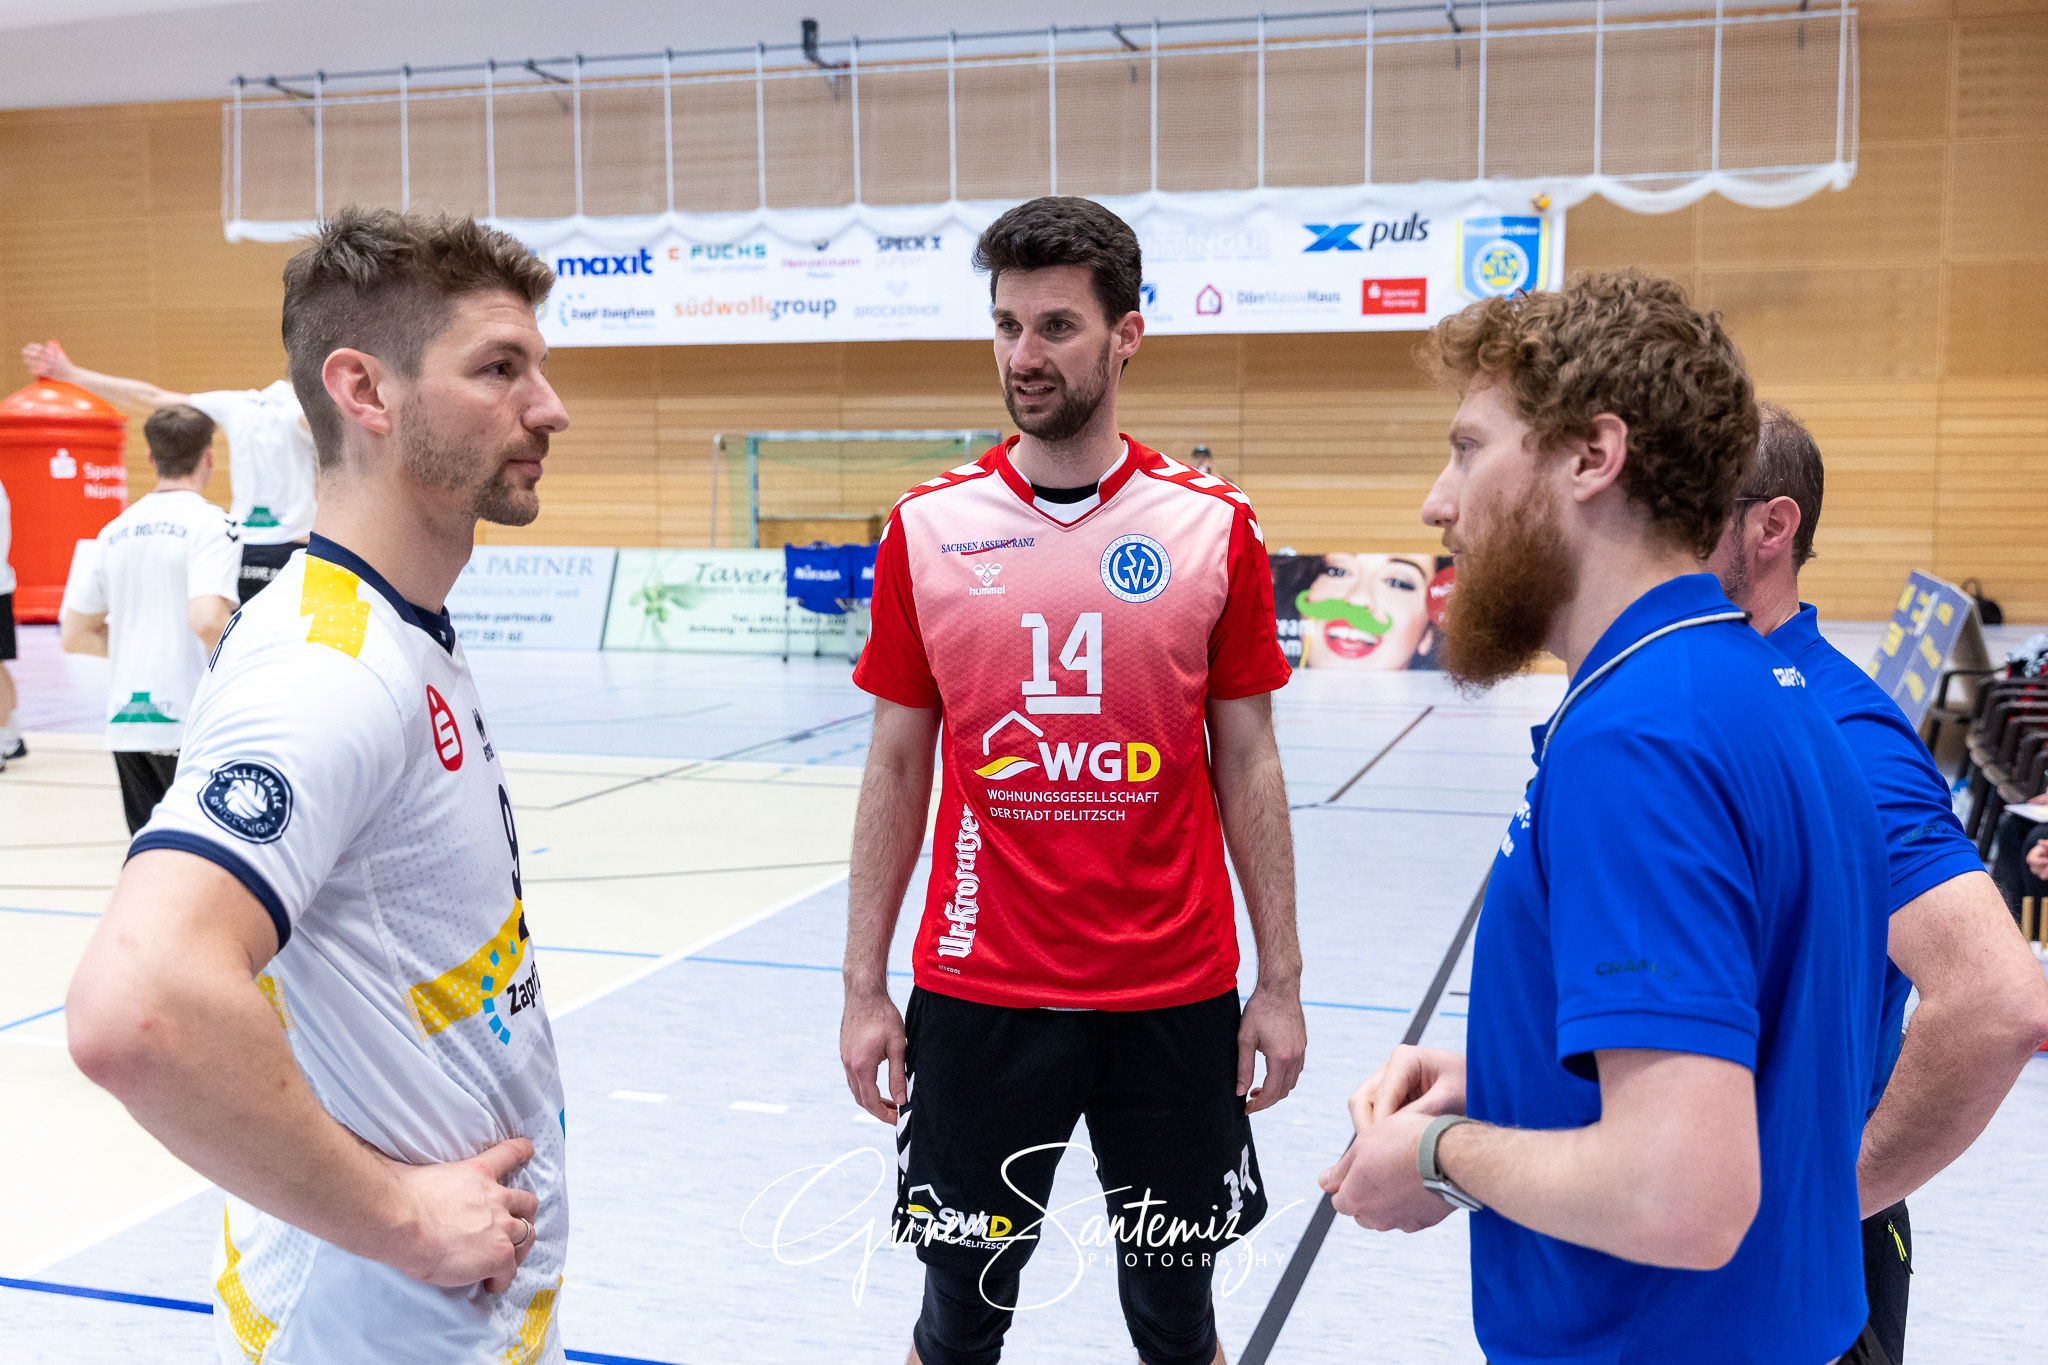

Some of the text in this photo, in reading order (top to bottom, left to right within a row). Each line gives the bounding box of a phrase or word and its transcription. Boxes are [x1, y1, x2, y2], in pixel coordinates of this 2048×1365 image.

[1370, 213, 1430, 250] puls
[558, 247, 653, 277] maxit
[691, 243, 768, 260] FUCHS
[941, 537, 1035, 553] SACHSEN ASSEKURANZ
[485, 556, 594, 577] PARTNER
[1102, 536, 1131, 581] GYMNASIALER
[1147, 540, 1170, 580] EHRENBERG
[969, 585, 1006, 595] hummel
[1114, 588, 1159, 602] DELITZSCH
[1021, 612, 1102, 695] 14
[1038, 742, 1161, 782] WGD
[218, 769, 283, 810] VOLLEYBALL
[987, 789, 1159, 803] WOHNUNGSGESELLSCHAFT
[990, 806, 1126, 821] DER STADT DELITZSCH
[1595, 960, 1659, 976] CRAFT
[1223, 1144, 1257, 1220] 14
